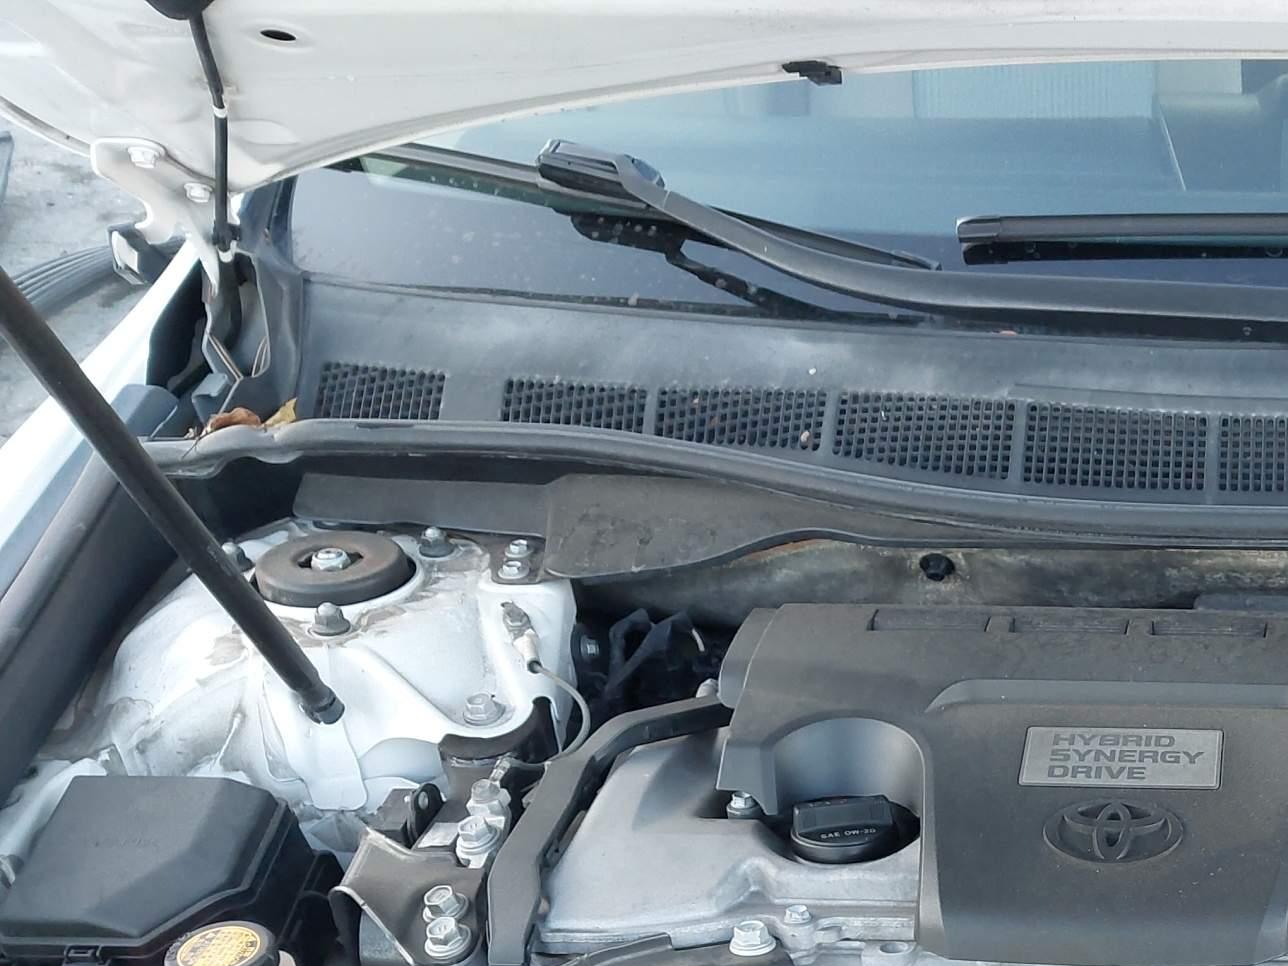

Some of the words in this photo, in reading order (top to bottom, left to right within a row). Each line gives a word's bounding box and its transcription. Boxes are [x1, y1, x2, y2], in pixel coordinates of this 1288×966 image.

[1052, 733, 1175, 748] HYBRID
[1049, 748, 1205, 764] SYNERGY
[1047, 764, 1146, 780] DRIVE
[820, 831, 841, 839] SAE
